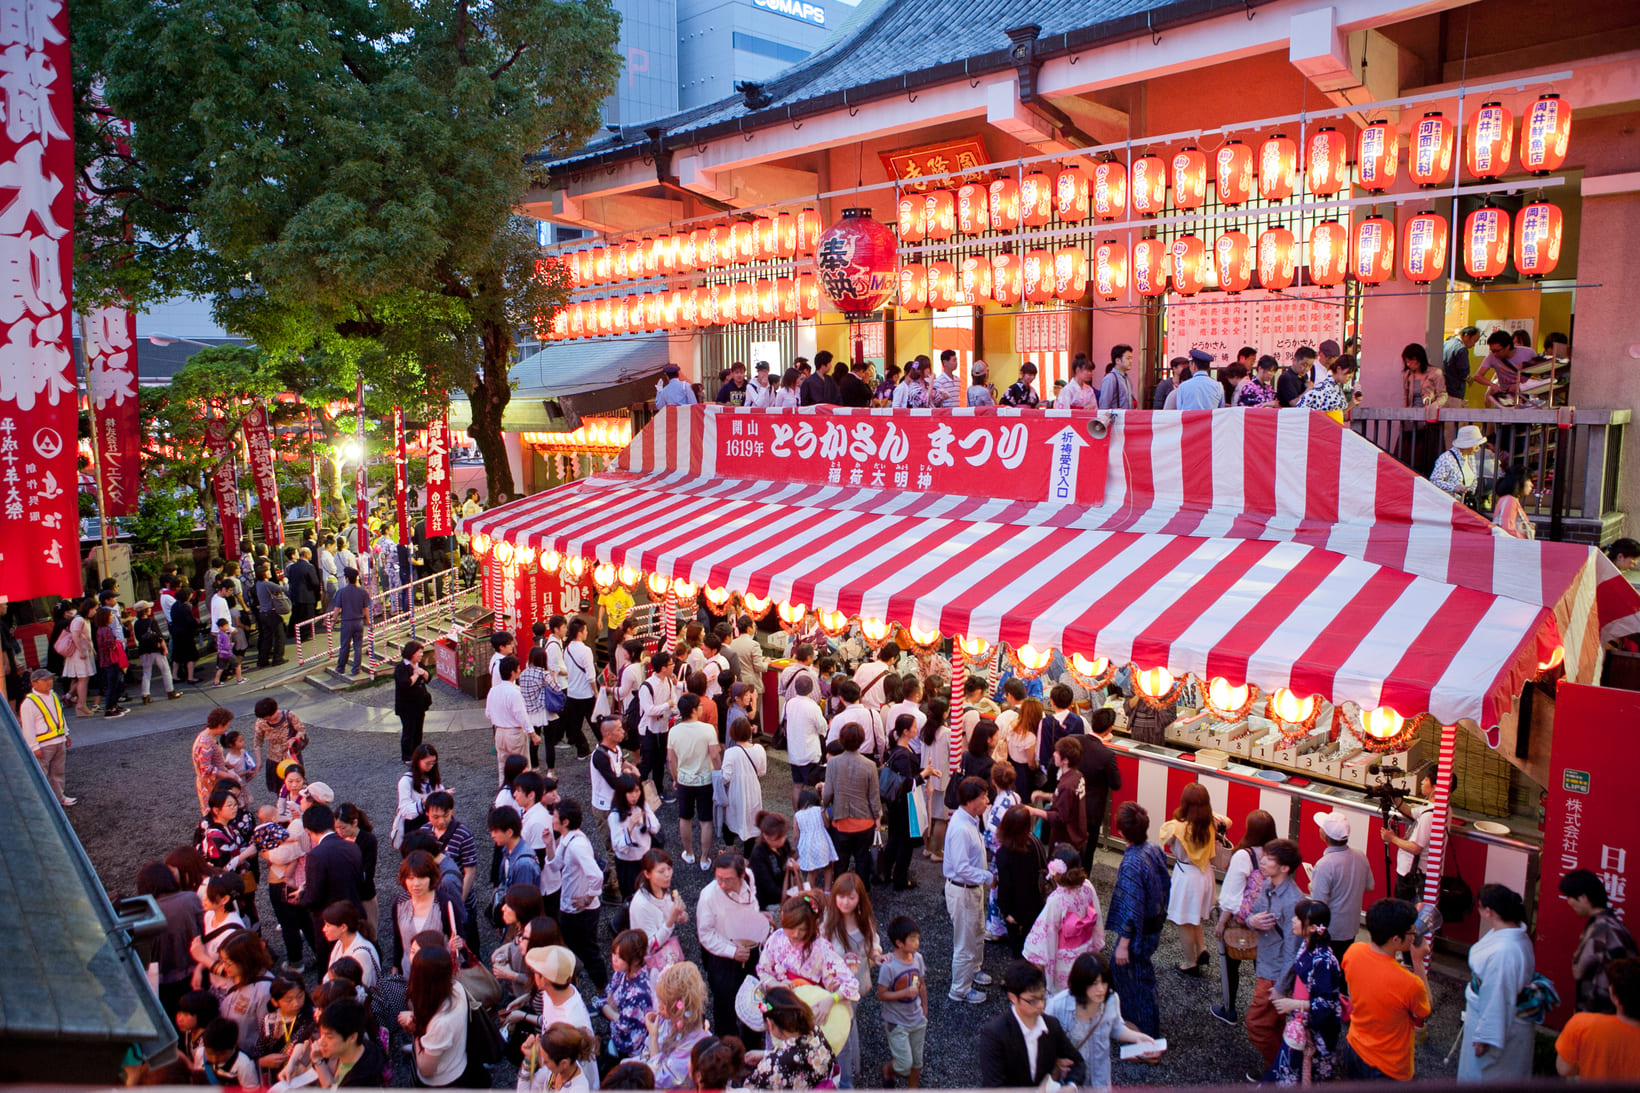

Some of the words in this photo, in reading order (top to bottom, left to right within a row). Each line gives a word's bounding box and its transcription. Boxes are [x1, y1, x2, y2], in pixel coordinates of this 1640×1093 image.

[628, 47, 649, 88] P
[1363, 128, 1375, 181] 河面内科
[1418, 121, 1433, 176] 河面内科
[1477, 110, 1492, 169] 岡井鮮魚店
[1530, 101, 1547, 164] 岡井鮮魚店
[960, 198, 970, 230] タナカ
[990, 194, 1000, 227] タナカ
[1360, 224, 1373, 275] 河面内科
[1410, 220, 1425, 272] 河面内科
[1473, 212, 1488, 271] 岡井鮮魚店
[1523, 207, 1539, 268] 岡井鮮魚店
[819, 237, 858, 298] 奉納
[1191, 341, 1227, 350] とうかさん
[1277, 339, 1316, 349] とうかさん
[726, 439, 764, 457] 1619年
[732, 419, 758, 436] 開山
[771, 421, 910, 463] とうかさん
[927, 422, 1029, 470] まつり
[828, 467, 933, 489] 稲荷大明神
[1566, 782, 1586, 792] LIFE
[1558, 797, 1583, 900] 株式会社ラ
